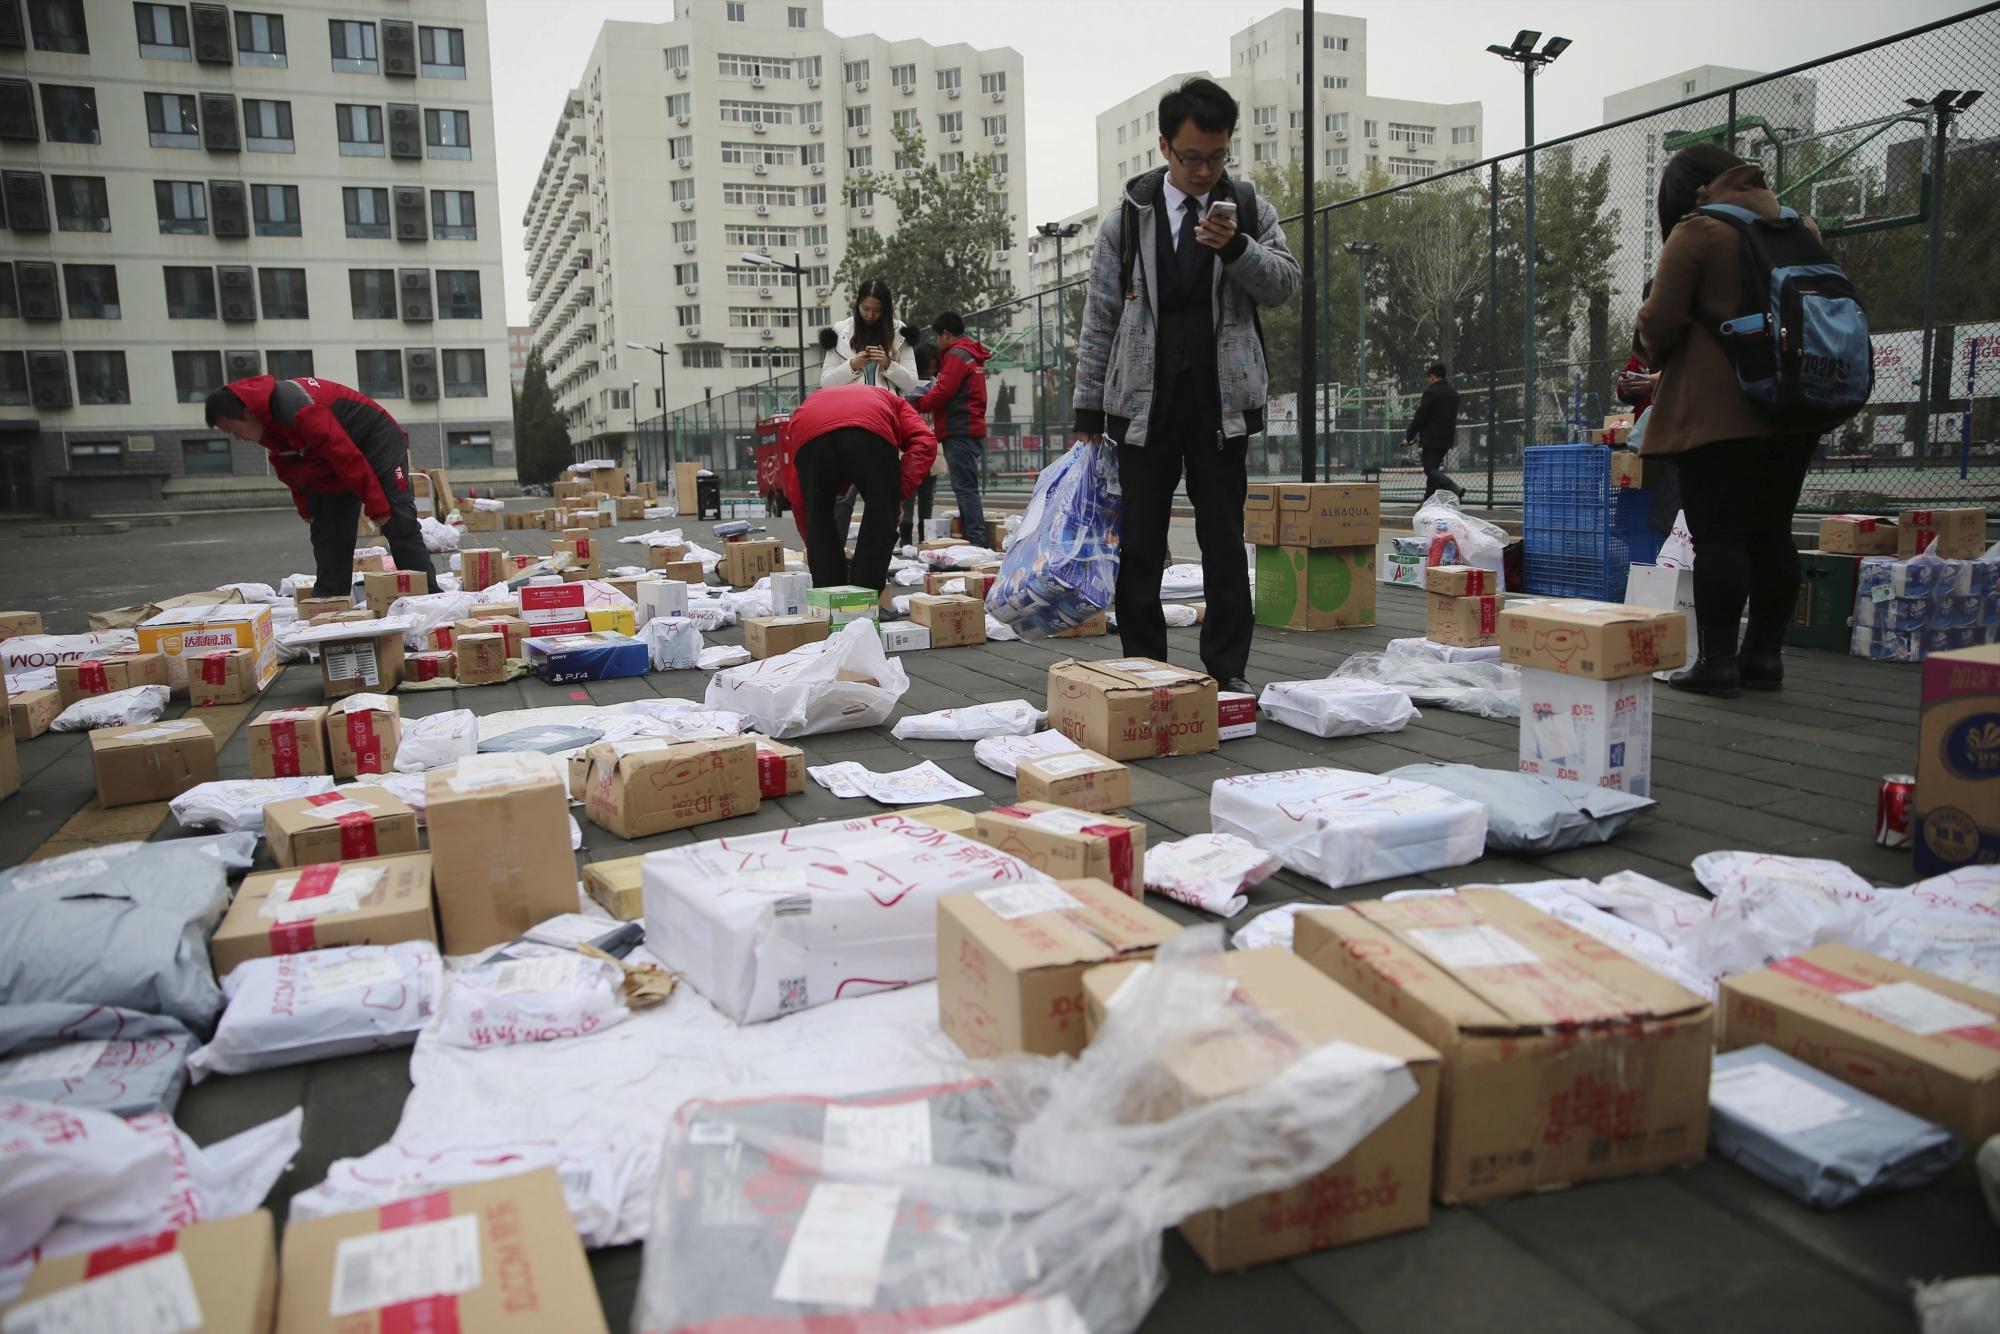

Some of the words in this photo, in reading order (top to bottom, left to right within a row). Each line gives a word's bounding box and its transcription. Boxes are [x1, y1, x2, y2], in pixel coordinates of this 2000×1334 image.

[1321, 507, 1369, 517] ALKAQUA
[565, 672, 588, 680] PS4
[1121, 728, 1153, 741] 京东
[1155, 720, 1206, 737] JD.COM
[694, 795, 715, 813] JD
